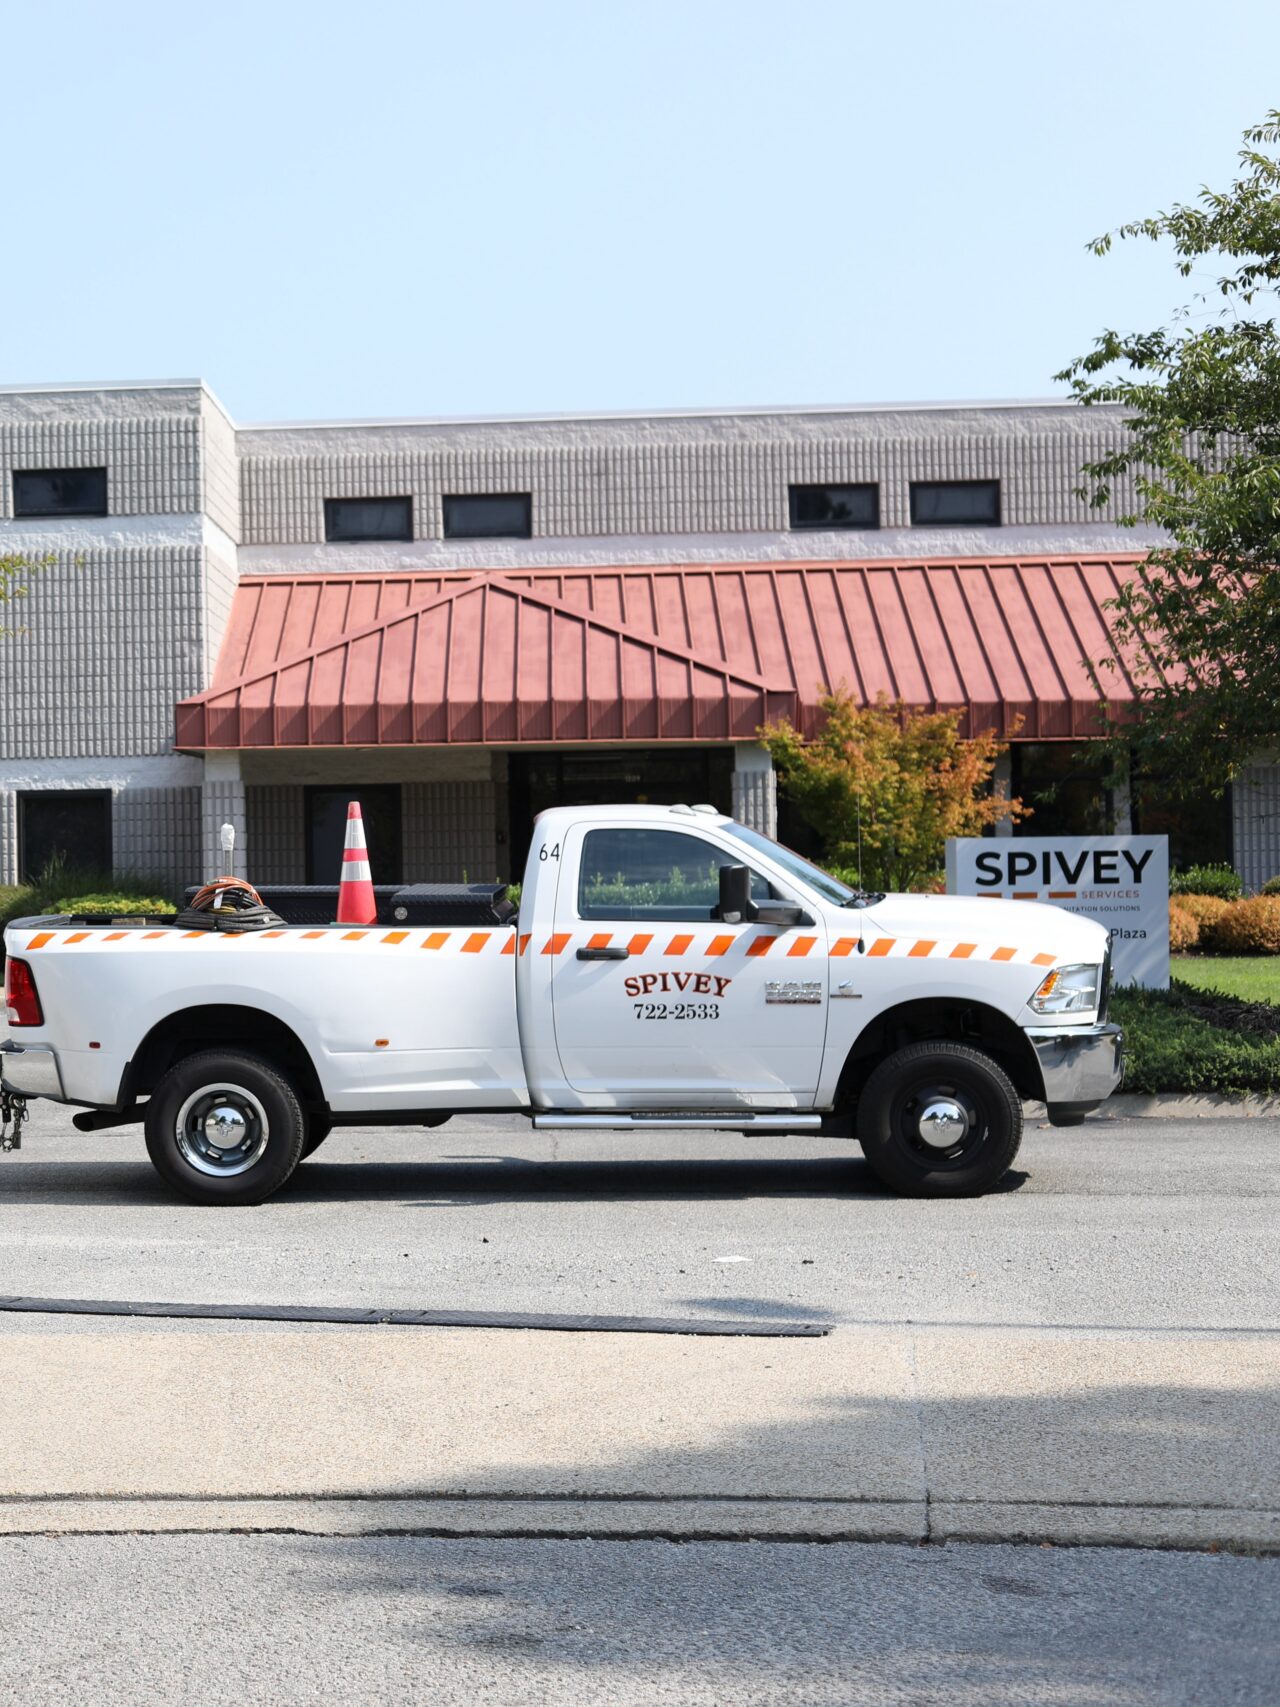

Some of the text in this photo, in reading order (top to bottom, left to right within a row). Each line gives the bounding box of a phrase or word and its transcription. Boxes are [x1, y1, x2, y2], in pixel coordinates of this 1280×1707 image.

[539, 843, 560, 862] 64
[975, 850, 1154, 887] SPIVEY
[1081, 889, 1140, 899] SERVICES
[1110, 928, 1147, 939] Plaza
[624, 971, 732, 998] SPIVEY
[634, 1003, 720, 1020] 722-2533
